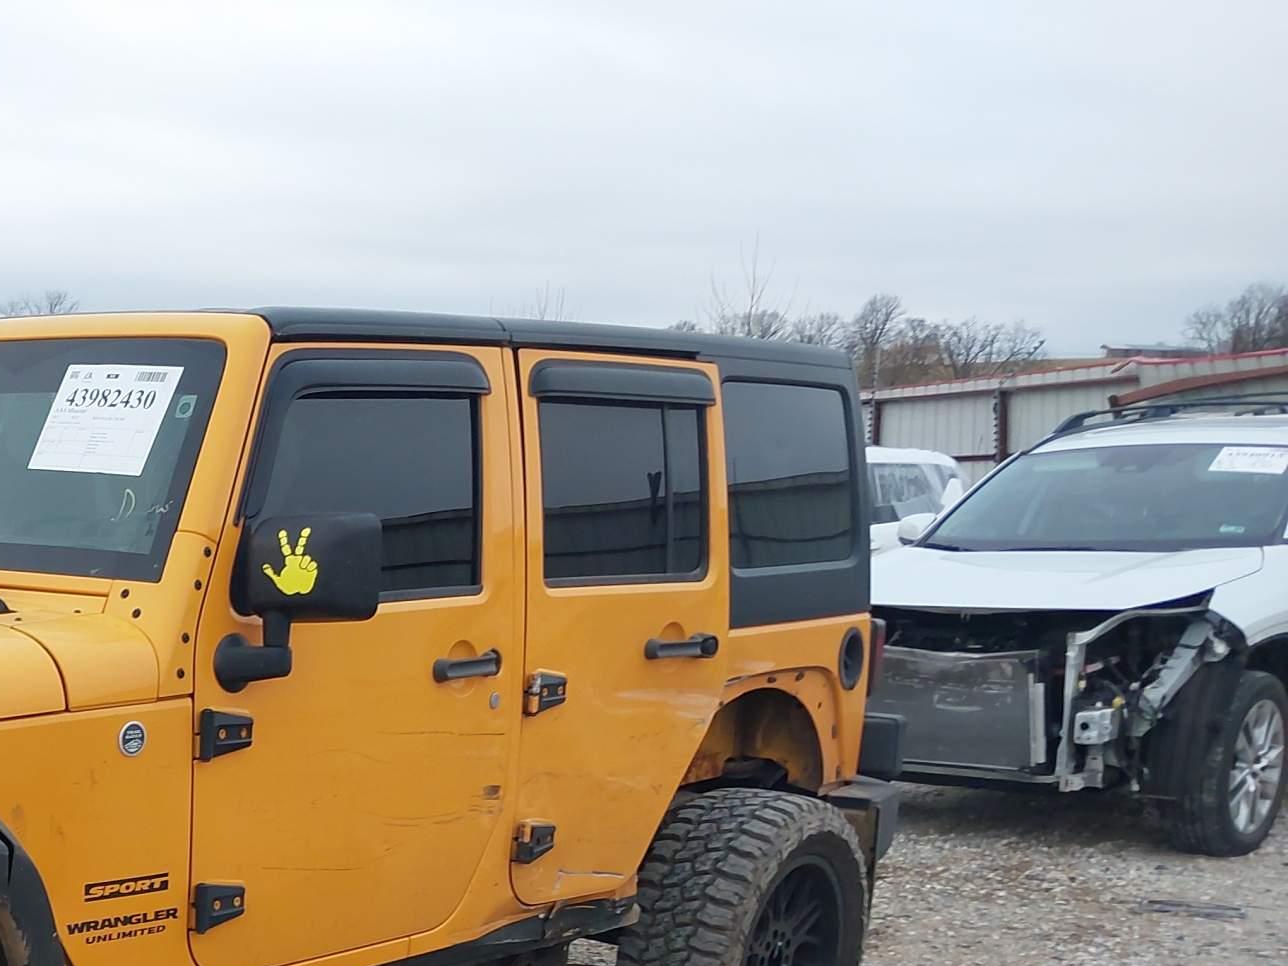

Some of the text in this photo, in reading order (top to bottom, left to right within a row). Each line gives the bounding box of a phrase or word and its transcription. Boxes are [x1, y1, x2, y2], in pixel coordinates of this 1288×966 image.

[66, 388, 156, 409] 43982430
[87, 877, 165, 898] SPORT
[67, 908, 178, 935] WRANGLER
[86, 925, 166, 944] UNLIMITED
